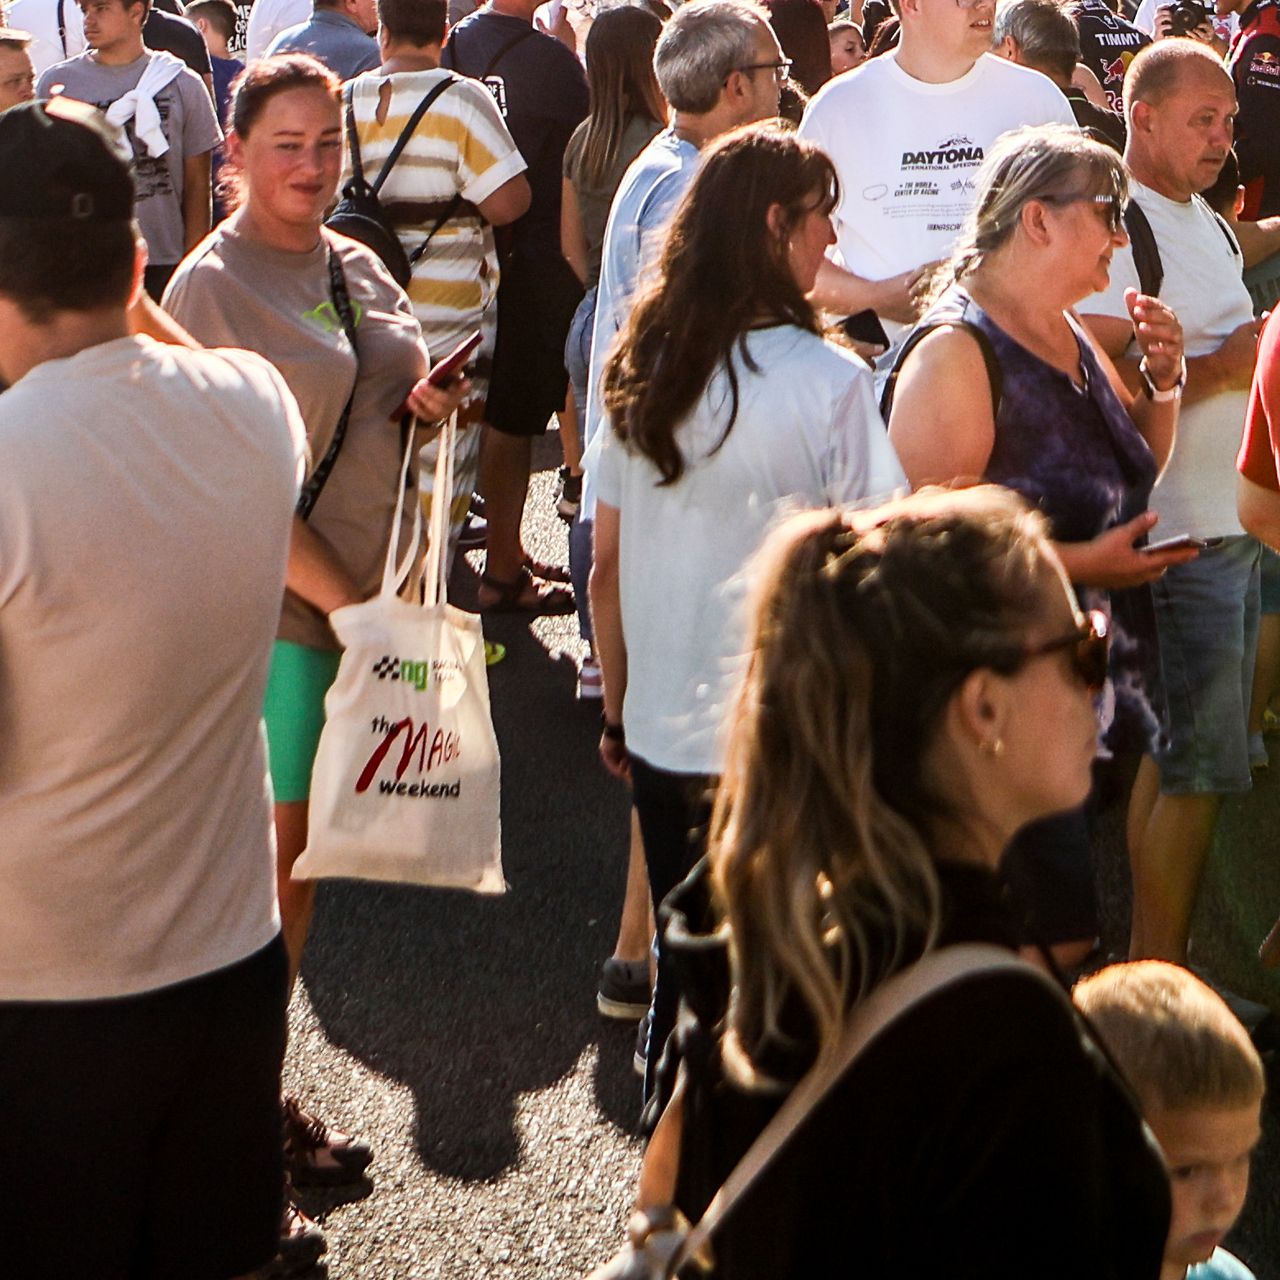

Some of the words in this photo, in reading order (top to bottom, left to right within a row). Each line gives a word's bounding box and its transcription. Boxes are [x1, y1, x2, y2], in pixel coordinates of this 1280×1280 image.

[1095, 32, 1141, 46] TIMMY
[1104, 90, 1125, 114] Re
[901, 147, 984, 166] DAYTONA
[371, 715, 398, 734] the
[380, 780, 461, 798] weekend
